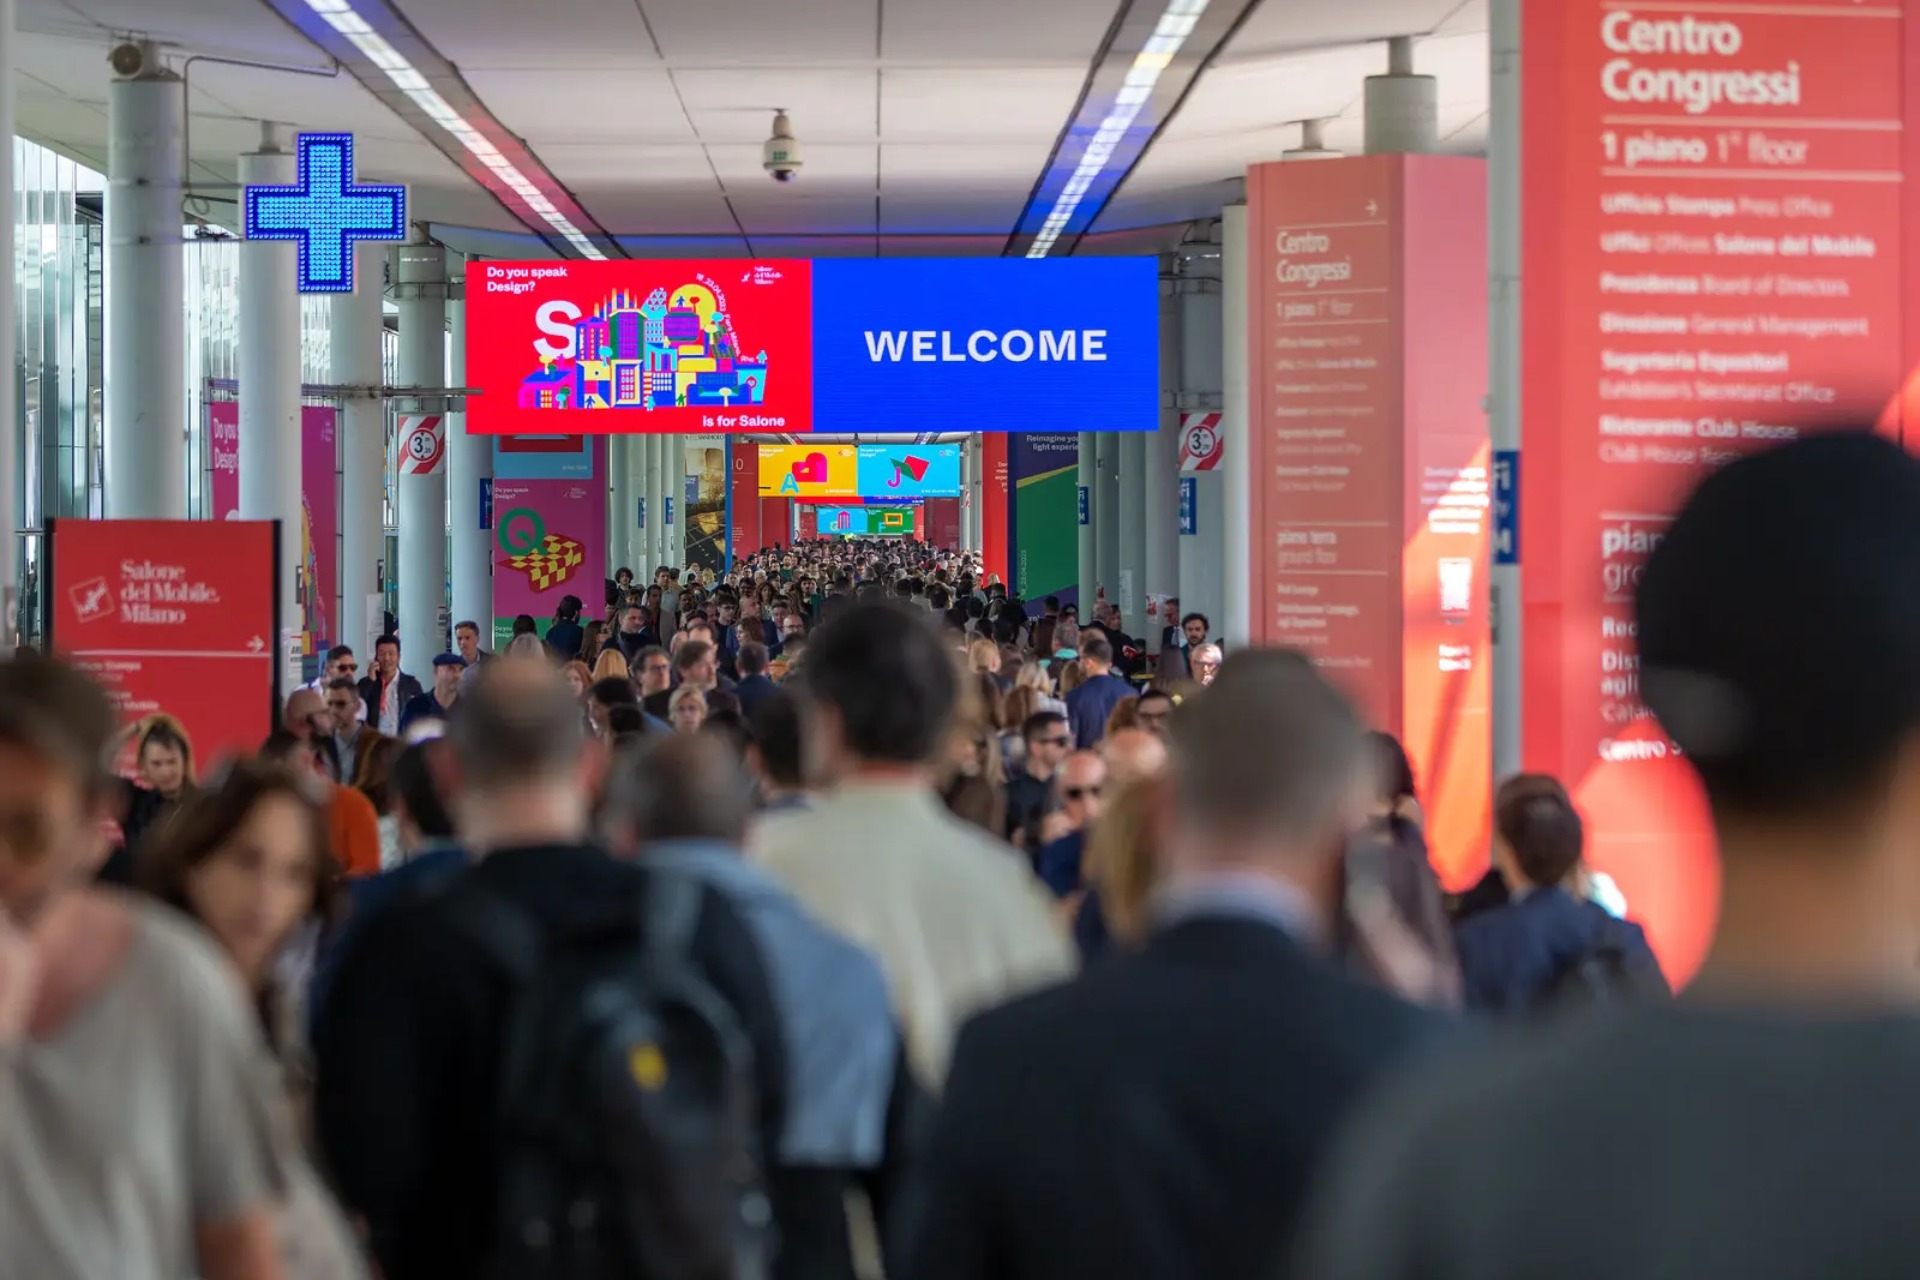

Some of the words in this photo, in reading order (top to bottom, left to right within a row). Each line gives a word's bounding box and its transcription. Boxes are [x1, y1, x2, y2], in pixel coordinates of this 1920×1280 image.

[1601, 11, 1742, 55] Centro
[1601, 58, 1800, 114] Congressi
[1602, 131, 1616, 161] 1
[1625, 130, 1708, 168] piano
[1748, 131, 1808, 164] floor
[1665, 194, 1735, 218] Stampa
[1276, 231, 1329, 254] Centro
[1714, 234, 1775, 254] Salone
[1811, 236, 1875, 257] Mobile
[487, 267, 502, 277] Do
[505, 269, 527, 280] you
[530, 267, 567, 280] speak
[1276, 256, 1351, 287] Congressi
[487, 281, 535, 294] Design?
[533, 300, 582, 360] S
[864, 329, 1107, 362] WELCOME
[1785, 383, 1835, 402] Office
[214, 417, 223, 439] Do
[224, 423, 236, 445] you
[703, 415, 714, 427] is
[717, 415, 736, 427] for
[739, 415, 785, 427] Salone
[1697, 418, 1738, 437] Club
[1741, 420, 1797, 439] House
[414, 437, 423, 453] 3
[1026, 434, 1066, 443] Reimagine
[1033, 443, 1050, 451] light
[1192, 432, 1201, 450] 3
[214, 446, 238, 474] Design
[780, 472, 799, 493] A
[887, 466, 900, 488] J
[498, 507, 546, 556] Q
[121, 559, 186, 580] Salone
[121, 582, 150, 601] del
[121, 602, 187, 624] Milano
[1600, 738, 1666, 761] Centro
